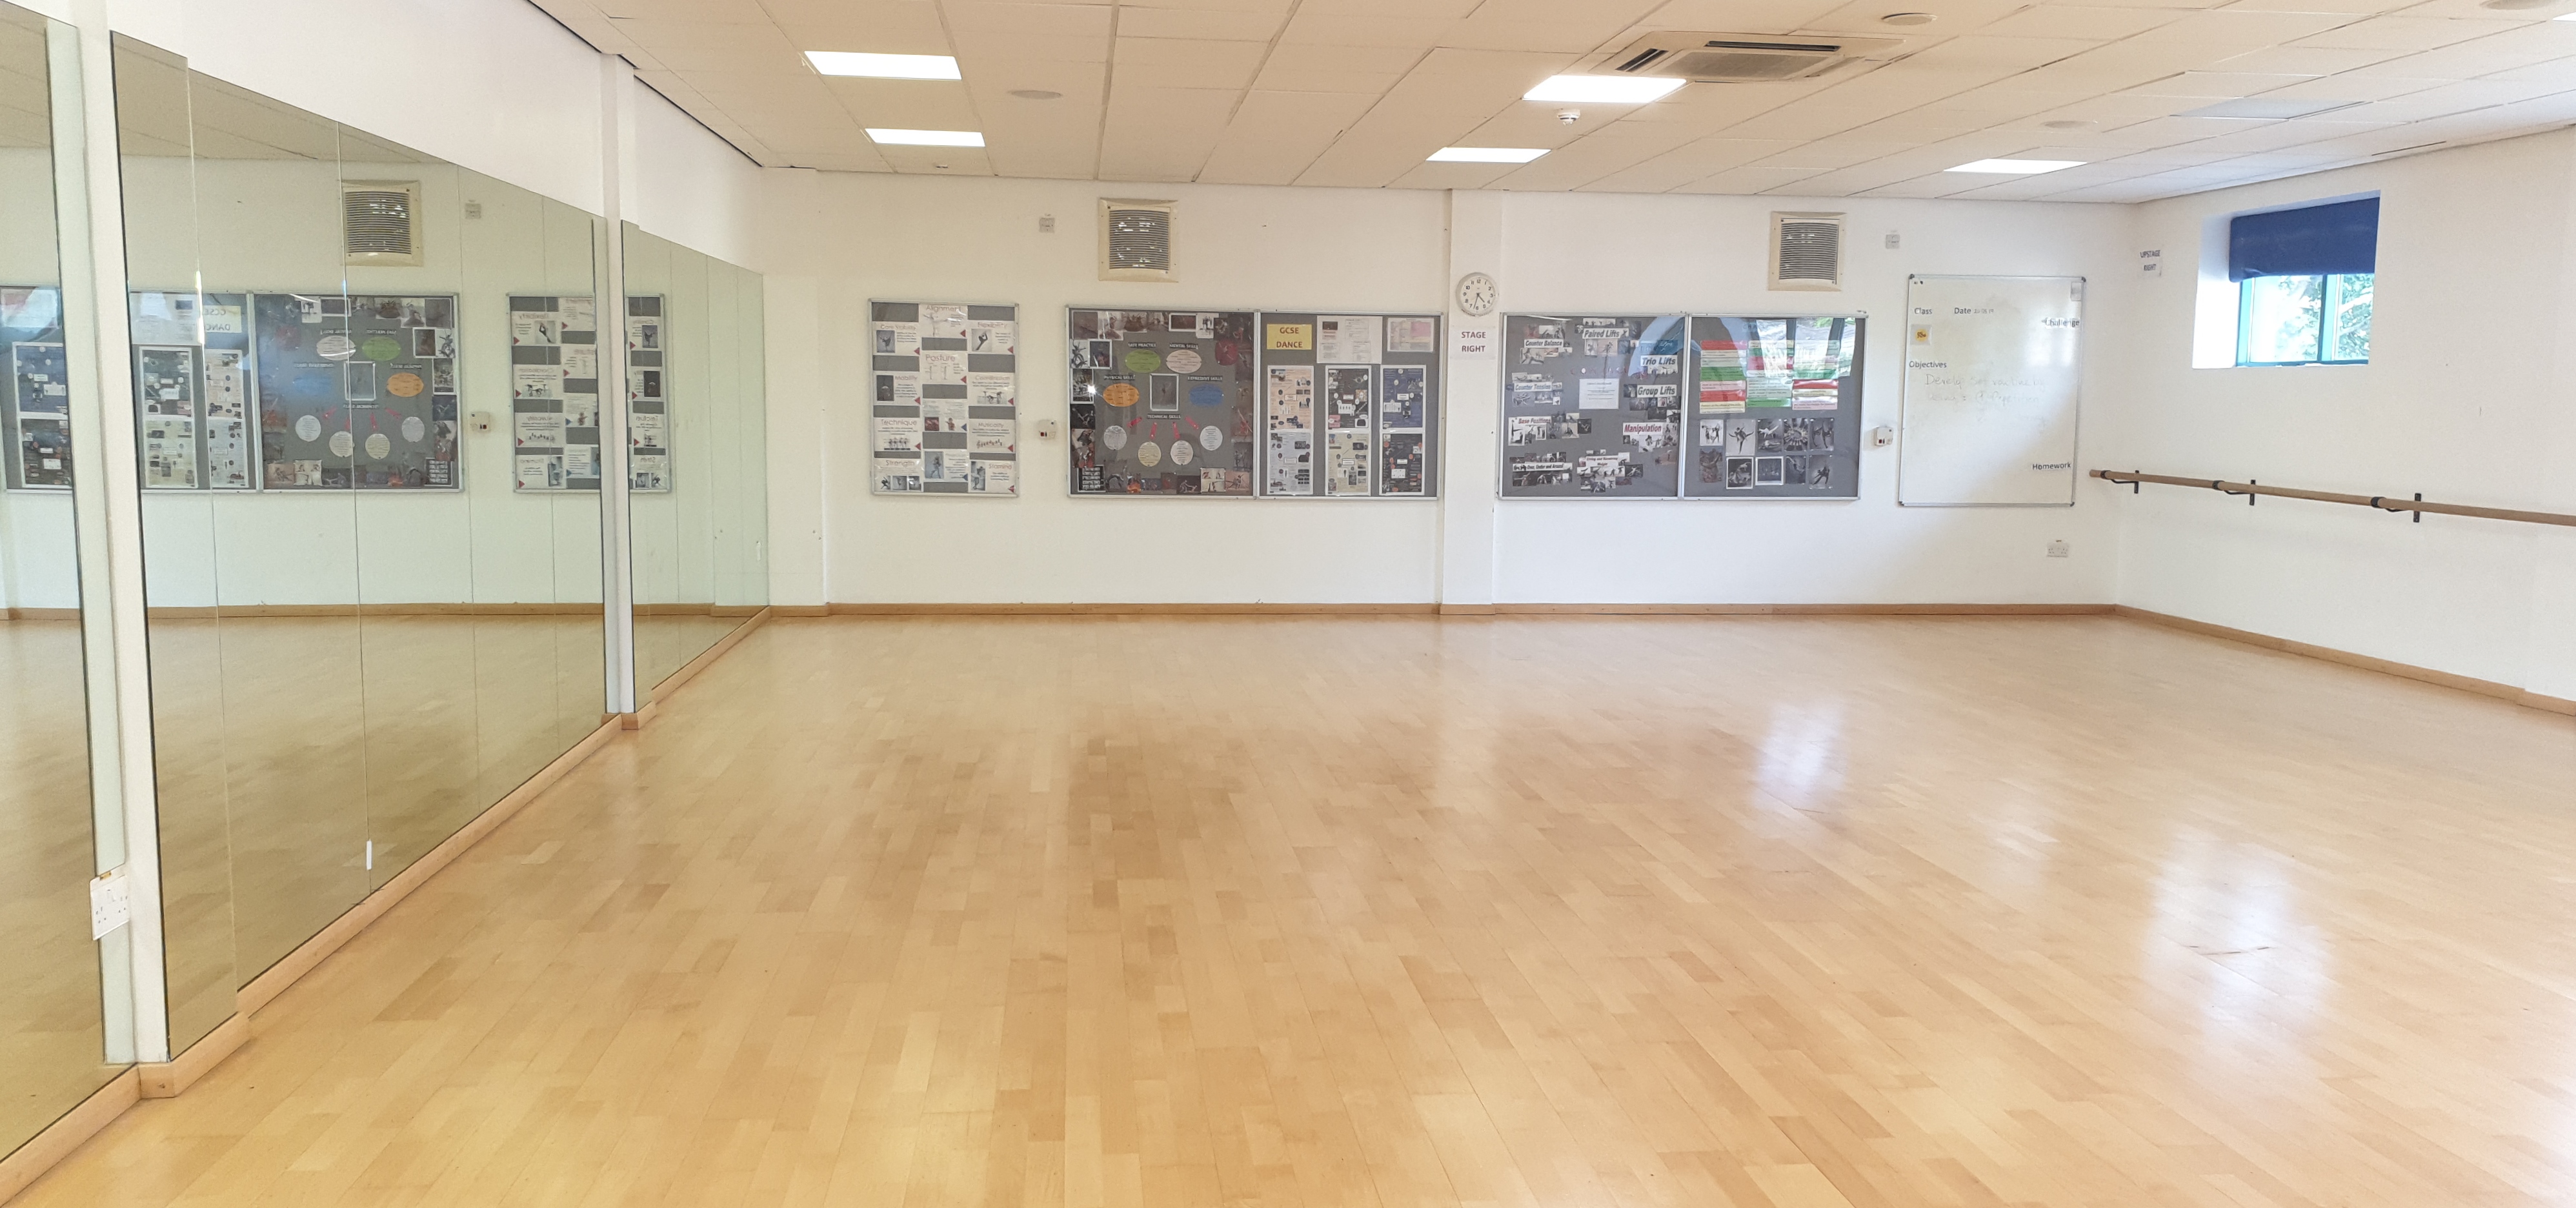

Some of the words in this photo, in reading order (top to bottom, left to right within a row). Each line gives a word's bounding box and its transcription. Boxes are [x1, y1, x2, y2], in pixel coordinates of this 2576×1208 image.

[1584, 330, 1604, 338] Paired
[925, 354, 956, 362] Posture
[1658, 357, 1676, 365] Lifts
[1909, 361, 1947, 369] Objectives
[1638, 388, 1658, 397] Group
[1624, 424, 1662, 434] Manipulation
[2033, 461, 2071, 470] Homework
